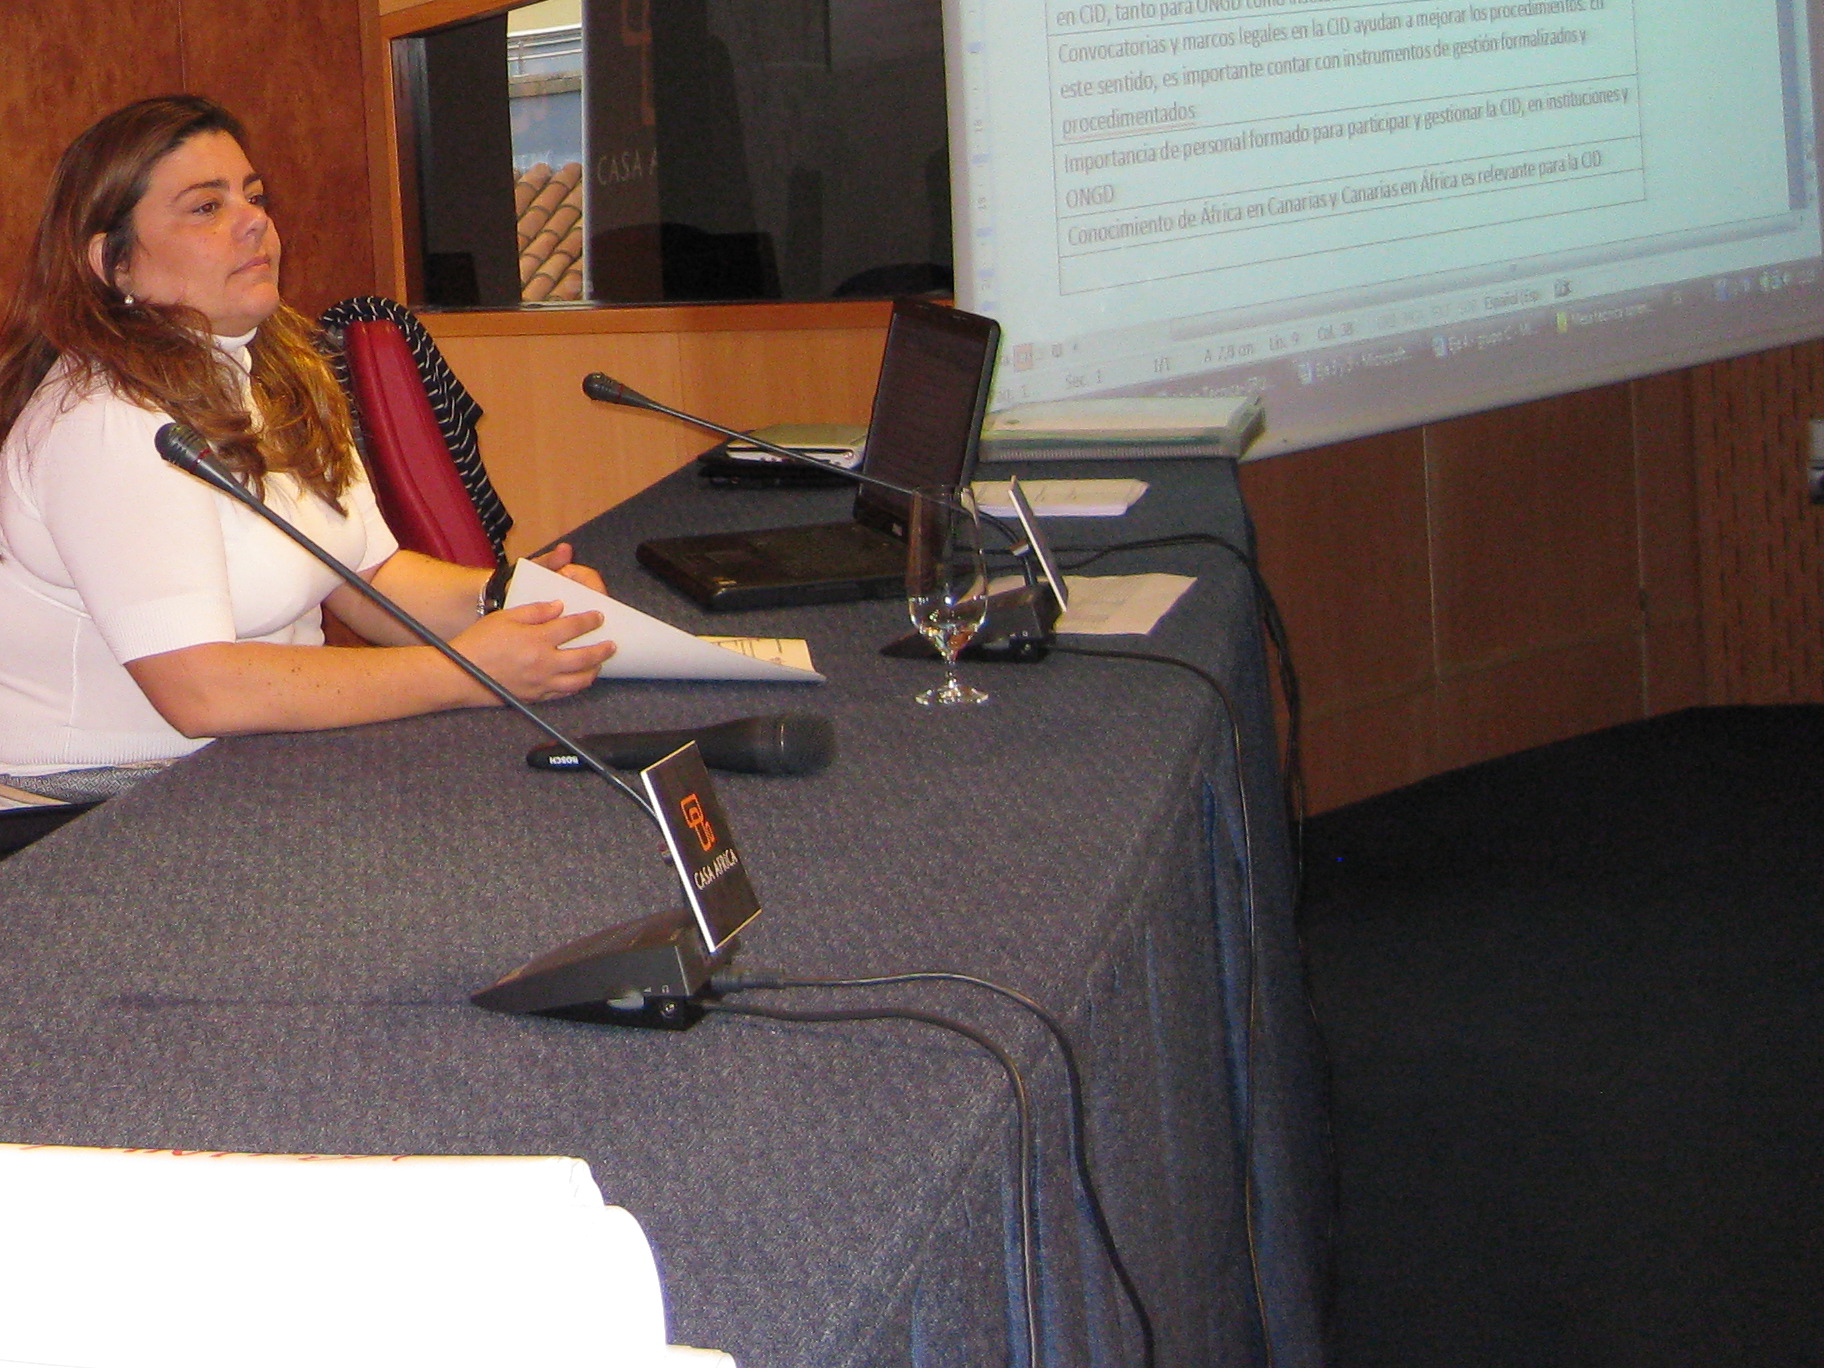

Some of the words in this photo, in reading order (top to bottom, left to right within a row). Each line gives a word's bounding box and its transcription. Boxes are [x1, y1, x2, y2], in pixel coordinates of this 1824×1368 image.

[1055, 11, 1076, 25] en
[1114, 0, 1156, 20] tanto
[1159, 0, 1194, 20] para
[1062, 102, 1197, 135] procedimentados
[1065, 183, 1116, 208] ONGD
[693, 865, 714, 891] CASA
[713, 848, 739, 879] AFRICA
